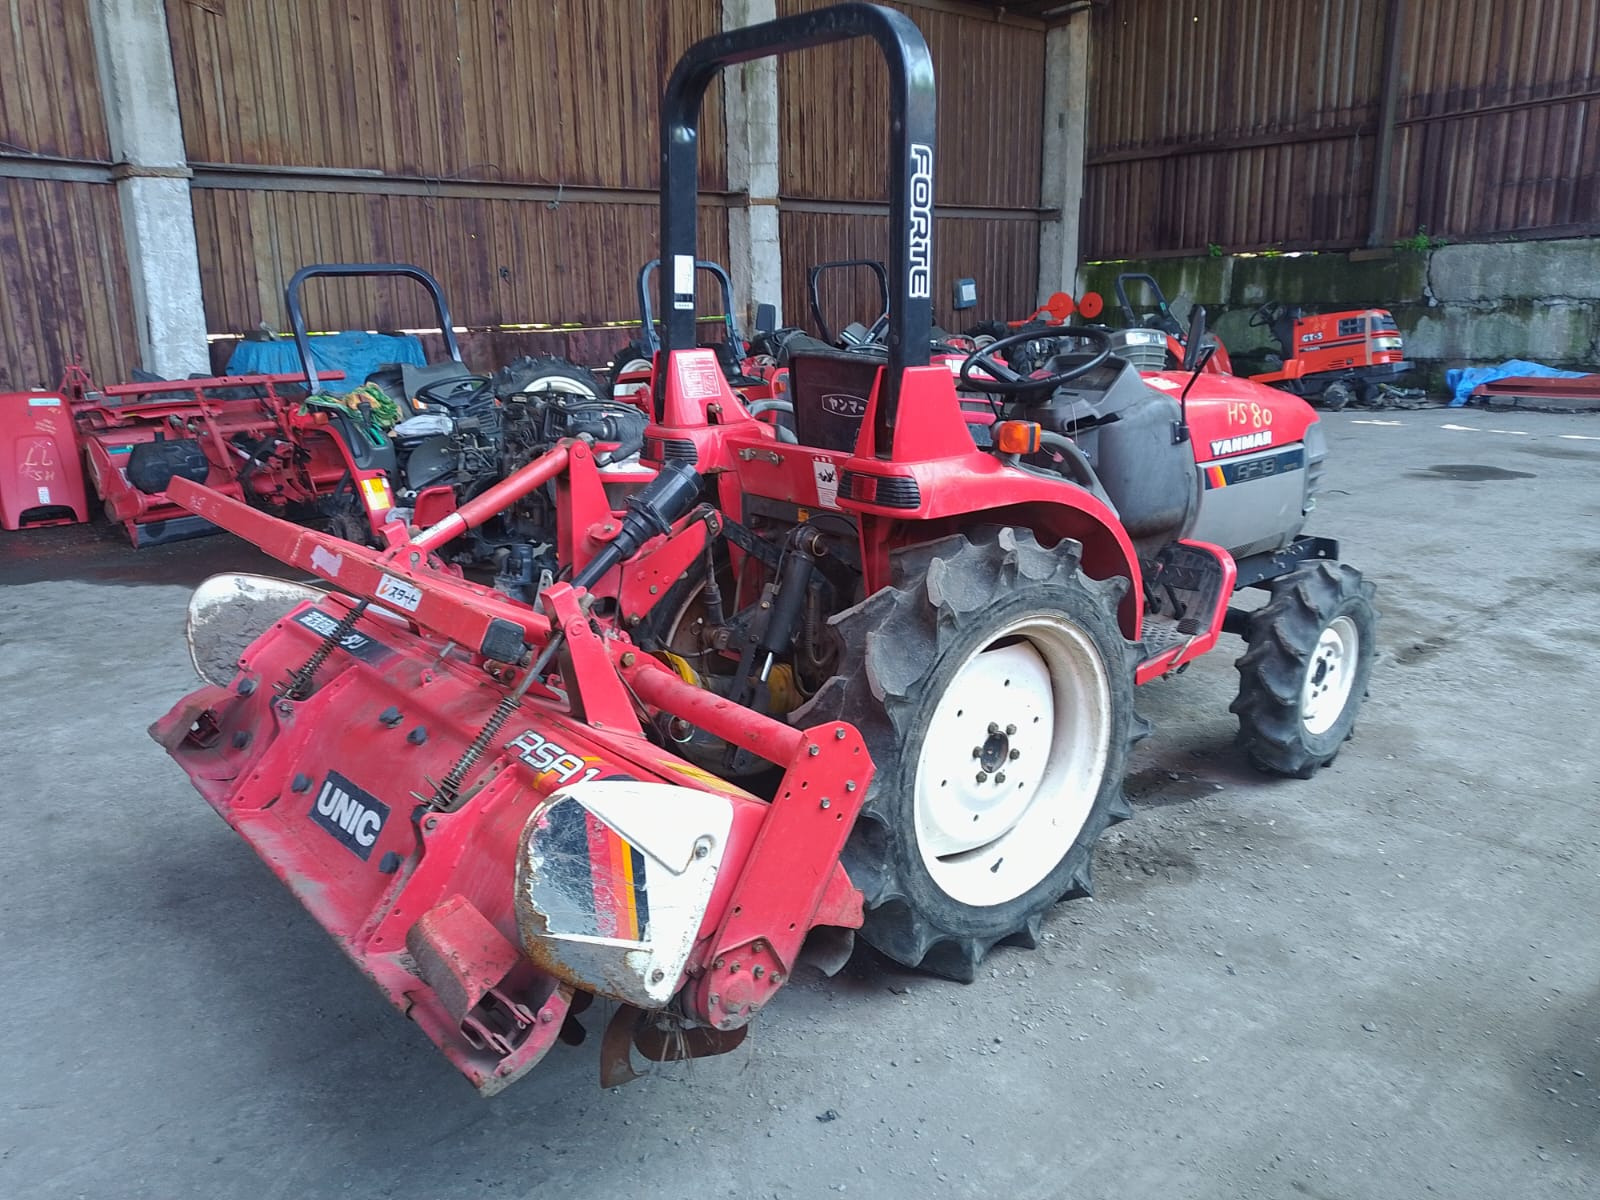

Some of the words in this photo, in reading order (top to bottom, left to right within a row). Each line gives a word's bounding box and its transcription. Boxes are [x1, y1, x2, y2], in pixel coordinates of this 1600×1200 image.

[909, 143, 933, 298] FORTE
[828, 396, 865, 414] ヤンマー
[1227, 403, 1248, 425] HS
[1251, 403, 1273, 428] 80
[1211, 431, 1273, 456] YANMAR
[388, 586, 417, 604] スタート
[316, 781, 381, 847] UNIC
